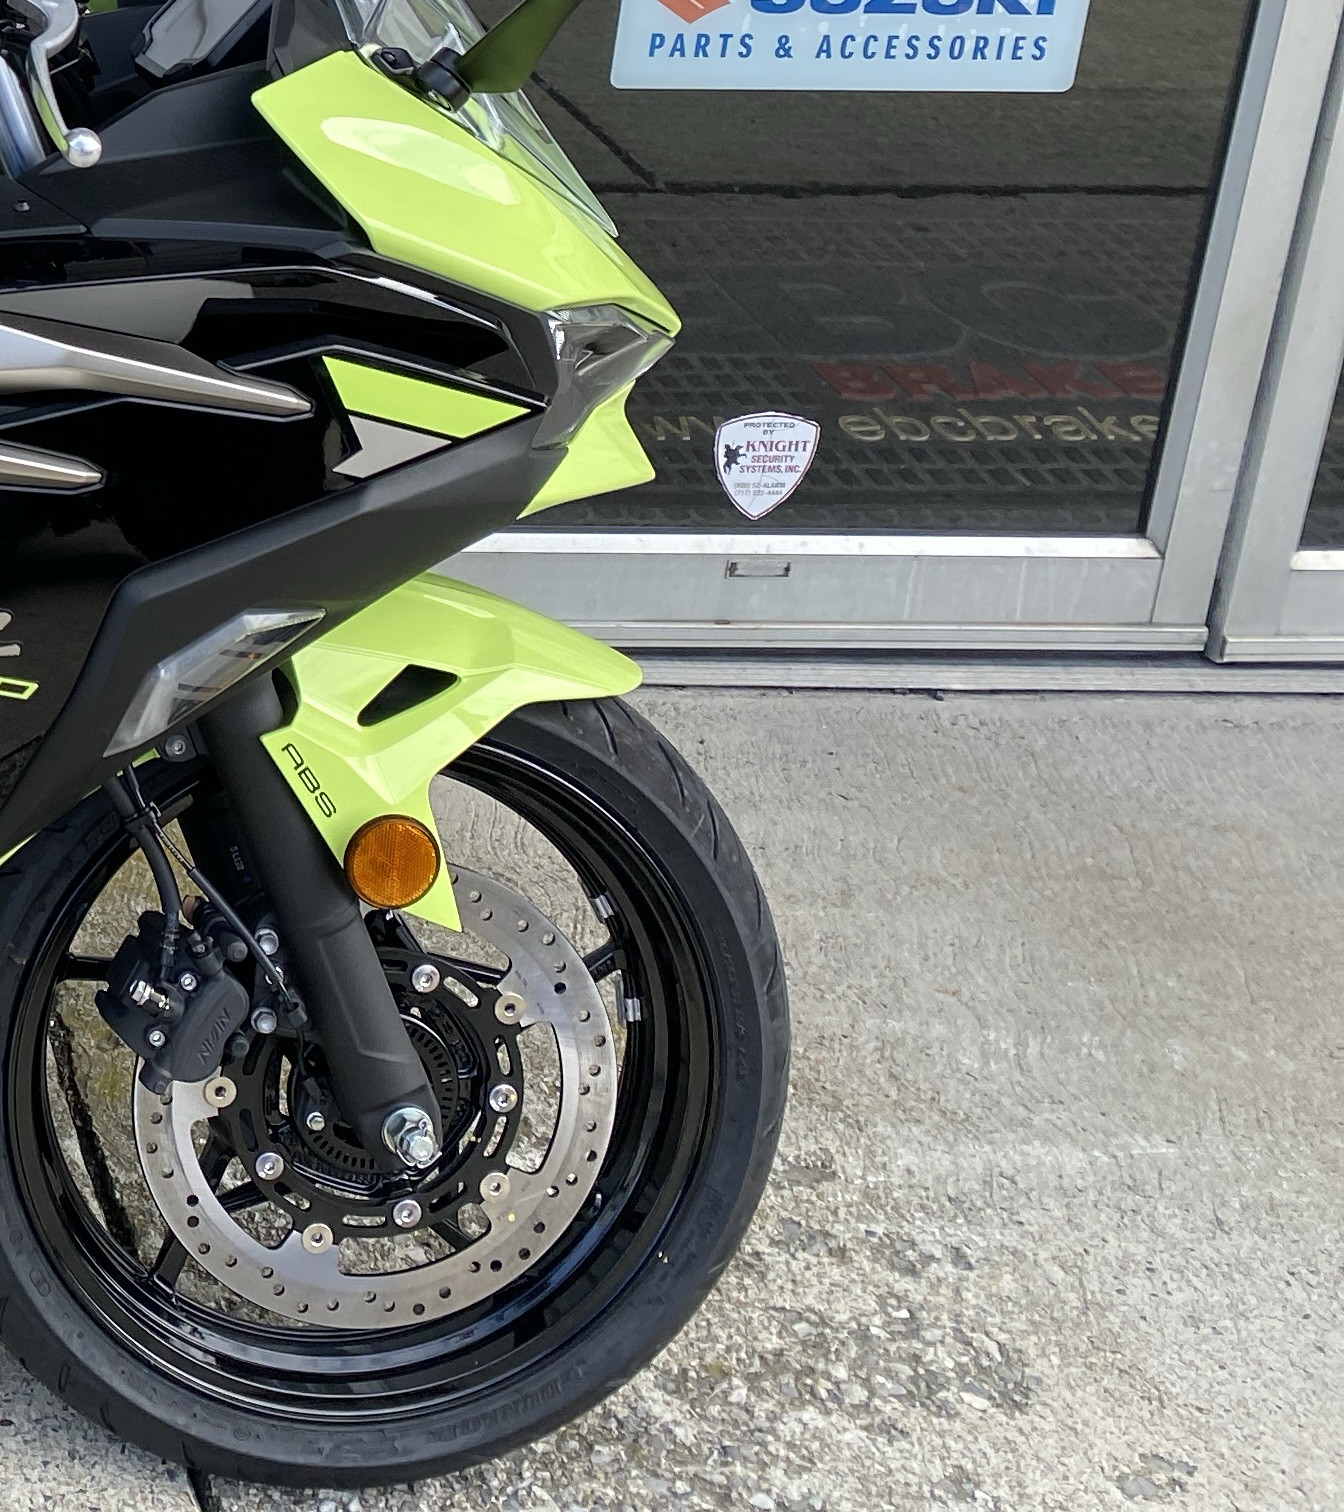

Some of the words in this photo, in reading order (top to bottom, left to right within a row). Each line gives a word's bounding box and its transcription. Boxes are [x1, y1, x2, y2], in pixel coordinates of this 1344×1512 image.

[647, 33, 755, 60] PARTS
[774, 34, 794, 60] &
[815, 34, 1049, 62] ACCESSORIES
[745, 440, 811, 453] KNIGHT
[750, 454, 795, 464] SECURITY
[785, 464, 802, 474] INC.
[280, 742, 338, 819] ABS
